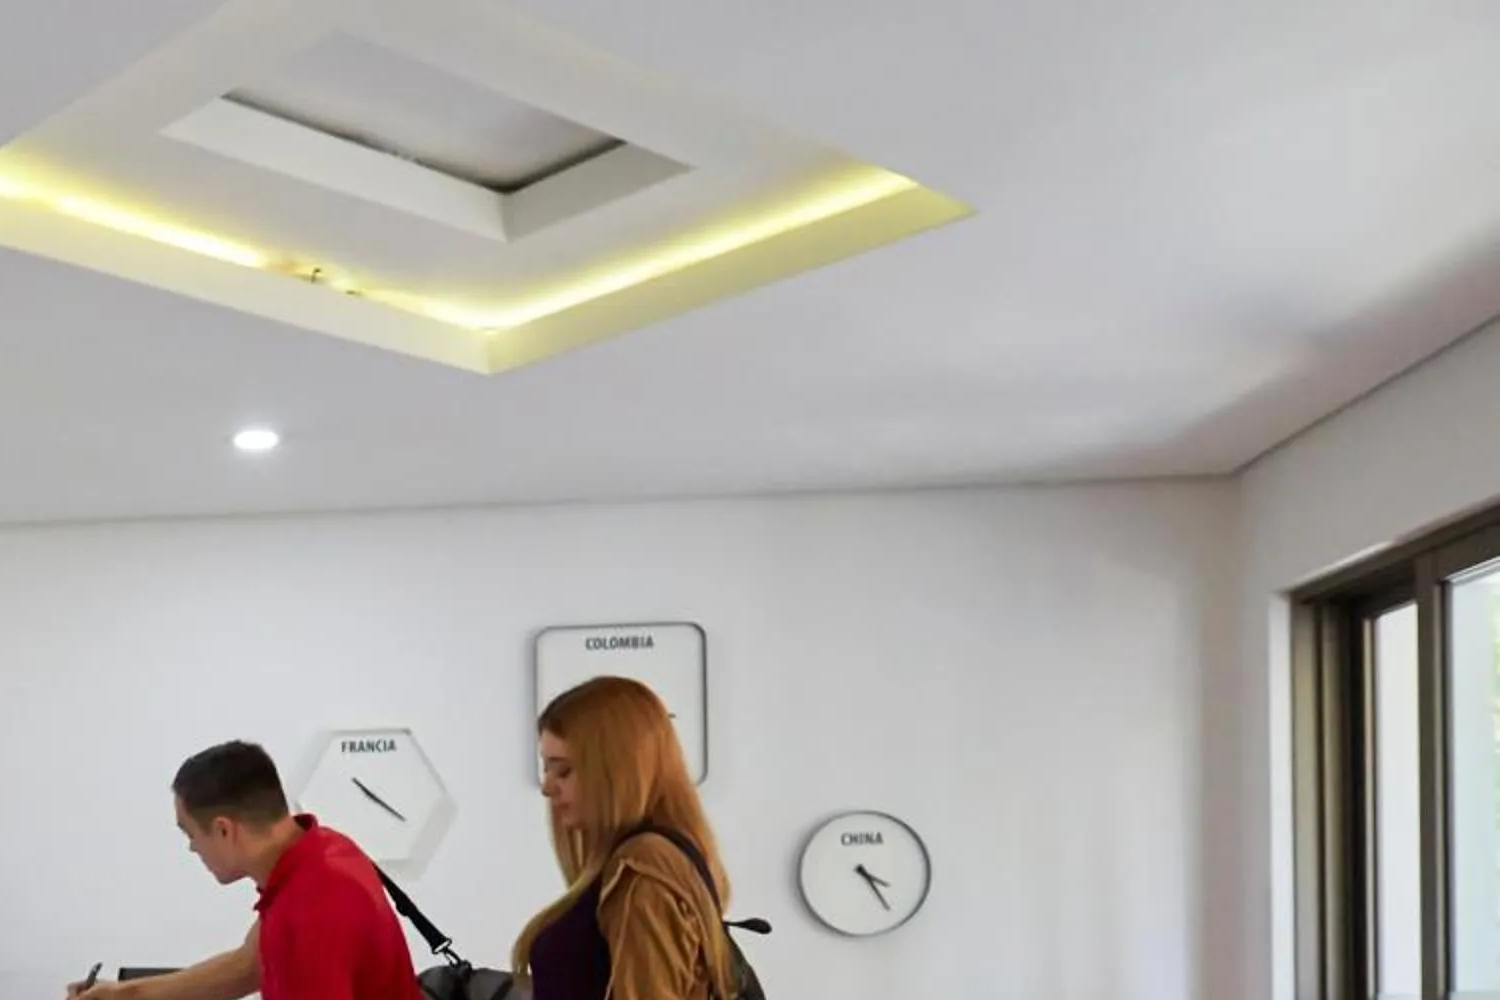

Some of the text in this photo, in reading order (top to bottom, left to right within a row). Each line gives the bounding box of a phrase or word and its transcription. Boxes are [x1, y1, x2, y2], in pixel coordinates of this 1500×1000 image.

[585, 636, 654, 650] COLOMBIA
[341, 739, 397, 753] FRANCIA
[841, 832, 884, 846] CHINA
